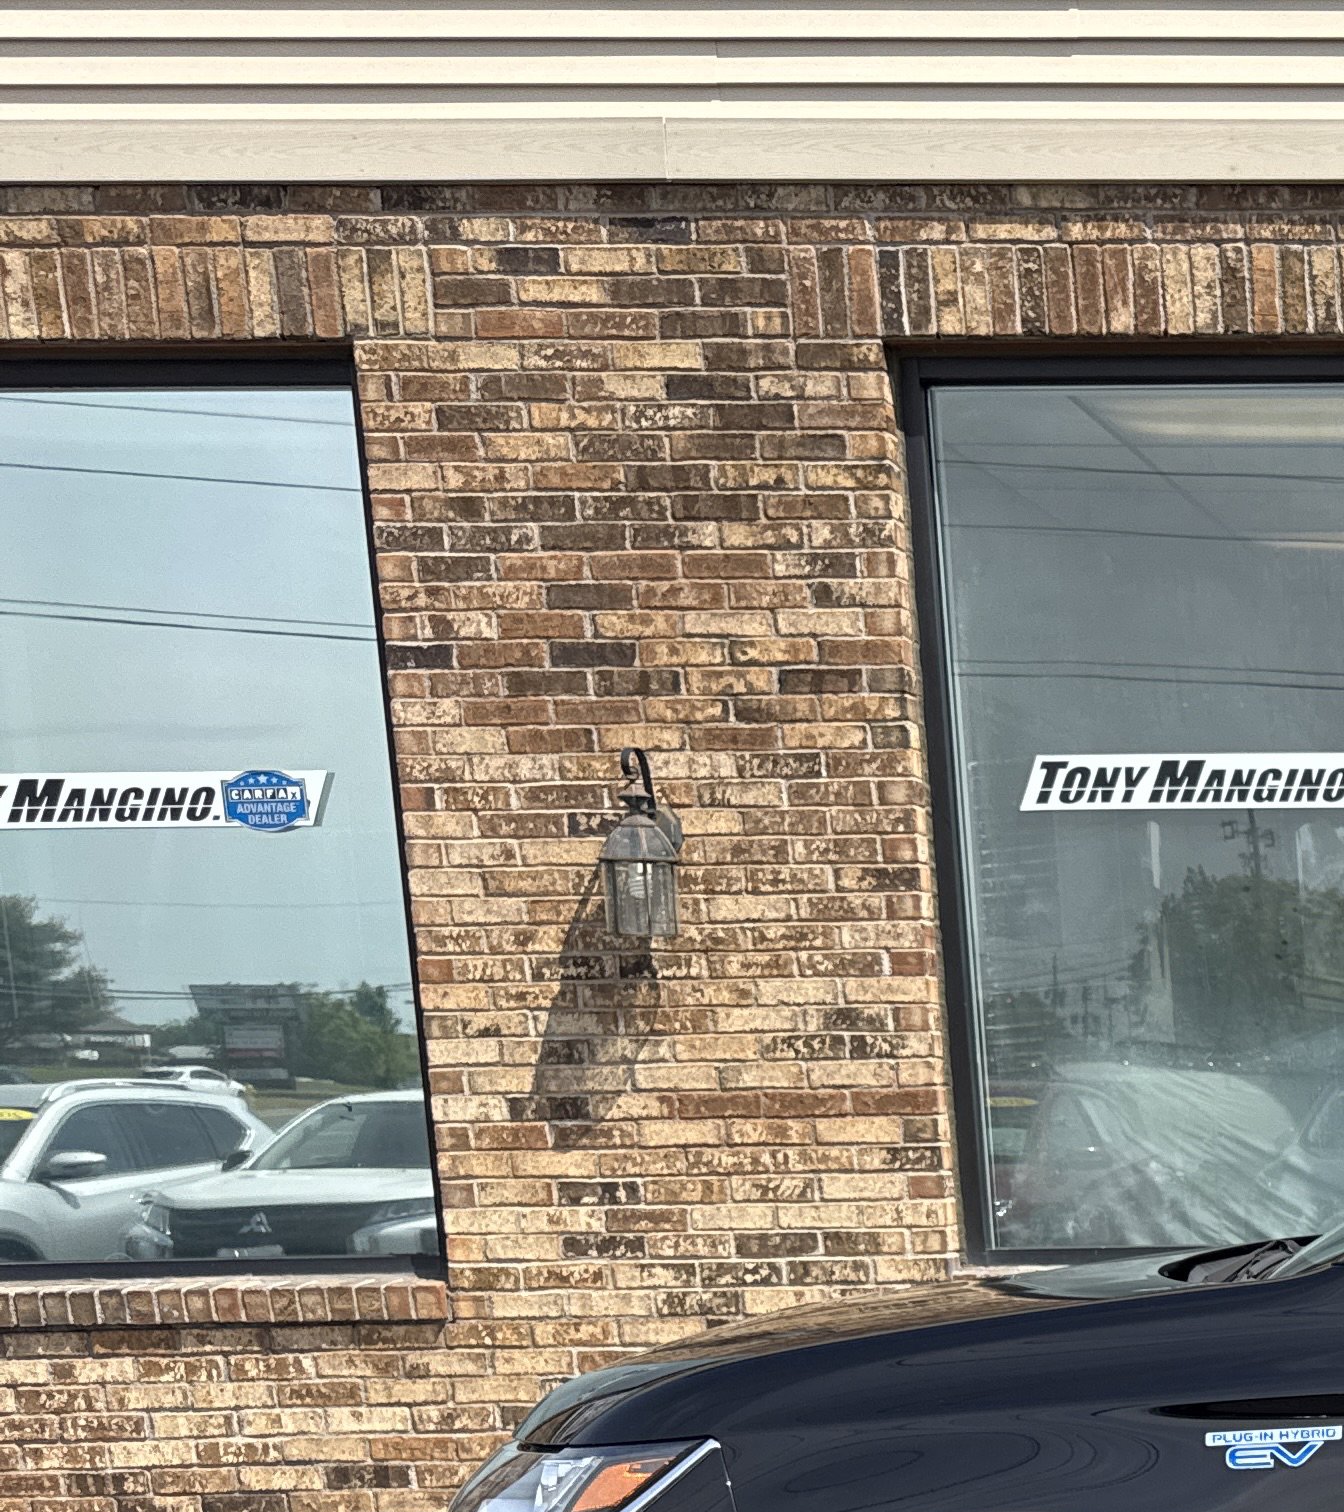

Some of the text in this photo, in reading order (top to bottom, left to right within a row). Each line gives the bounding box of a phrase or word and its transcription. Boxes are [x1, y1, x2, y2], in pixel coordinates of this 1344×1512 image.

[229, 786, 300, 801] CARFAX
[237, 801, 297, 815] ADVANTAGE
[248, 813, 288, 825] DEALER
[1212, 1428, 1337, 1444] PLUG-IN HYBRID
[1225, 1440, 1325, 1470] EV
